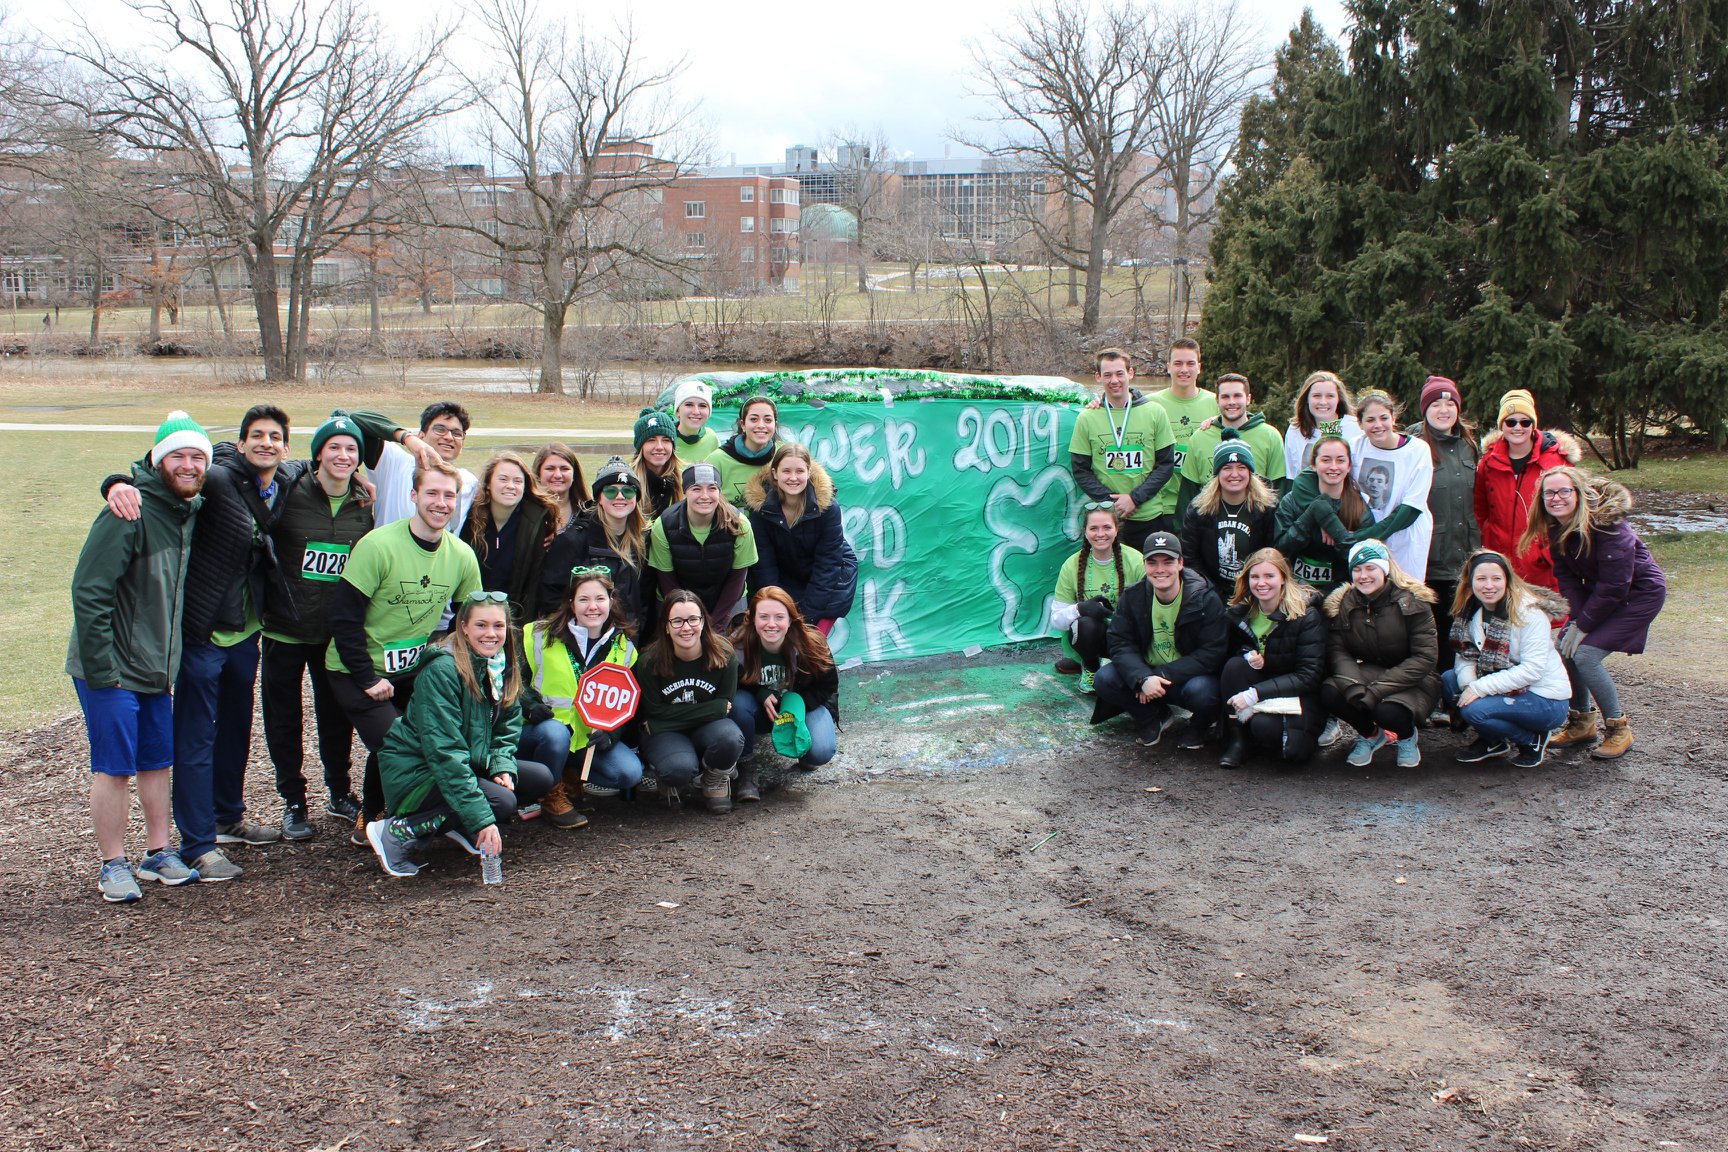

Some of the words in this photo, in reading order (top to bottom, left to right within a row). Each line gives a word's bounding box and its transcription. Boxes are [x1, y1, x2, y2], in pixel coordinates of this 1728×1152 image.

[953, 405, 1058, 473] 2019
[303, 550, 346, 575] 2028
[1294, 559, 1331, 581] 2644
[388, 592, 433, 606] Shamrock
[583, 680, 631, 711] STOP
[661, 678, 695, 696] MICHIGAN
[695, 679, 717, 695] STATE
